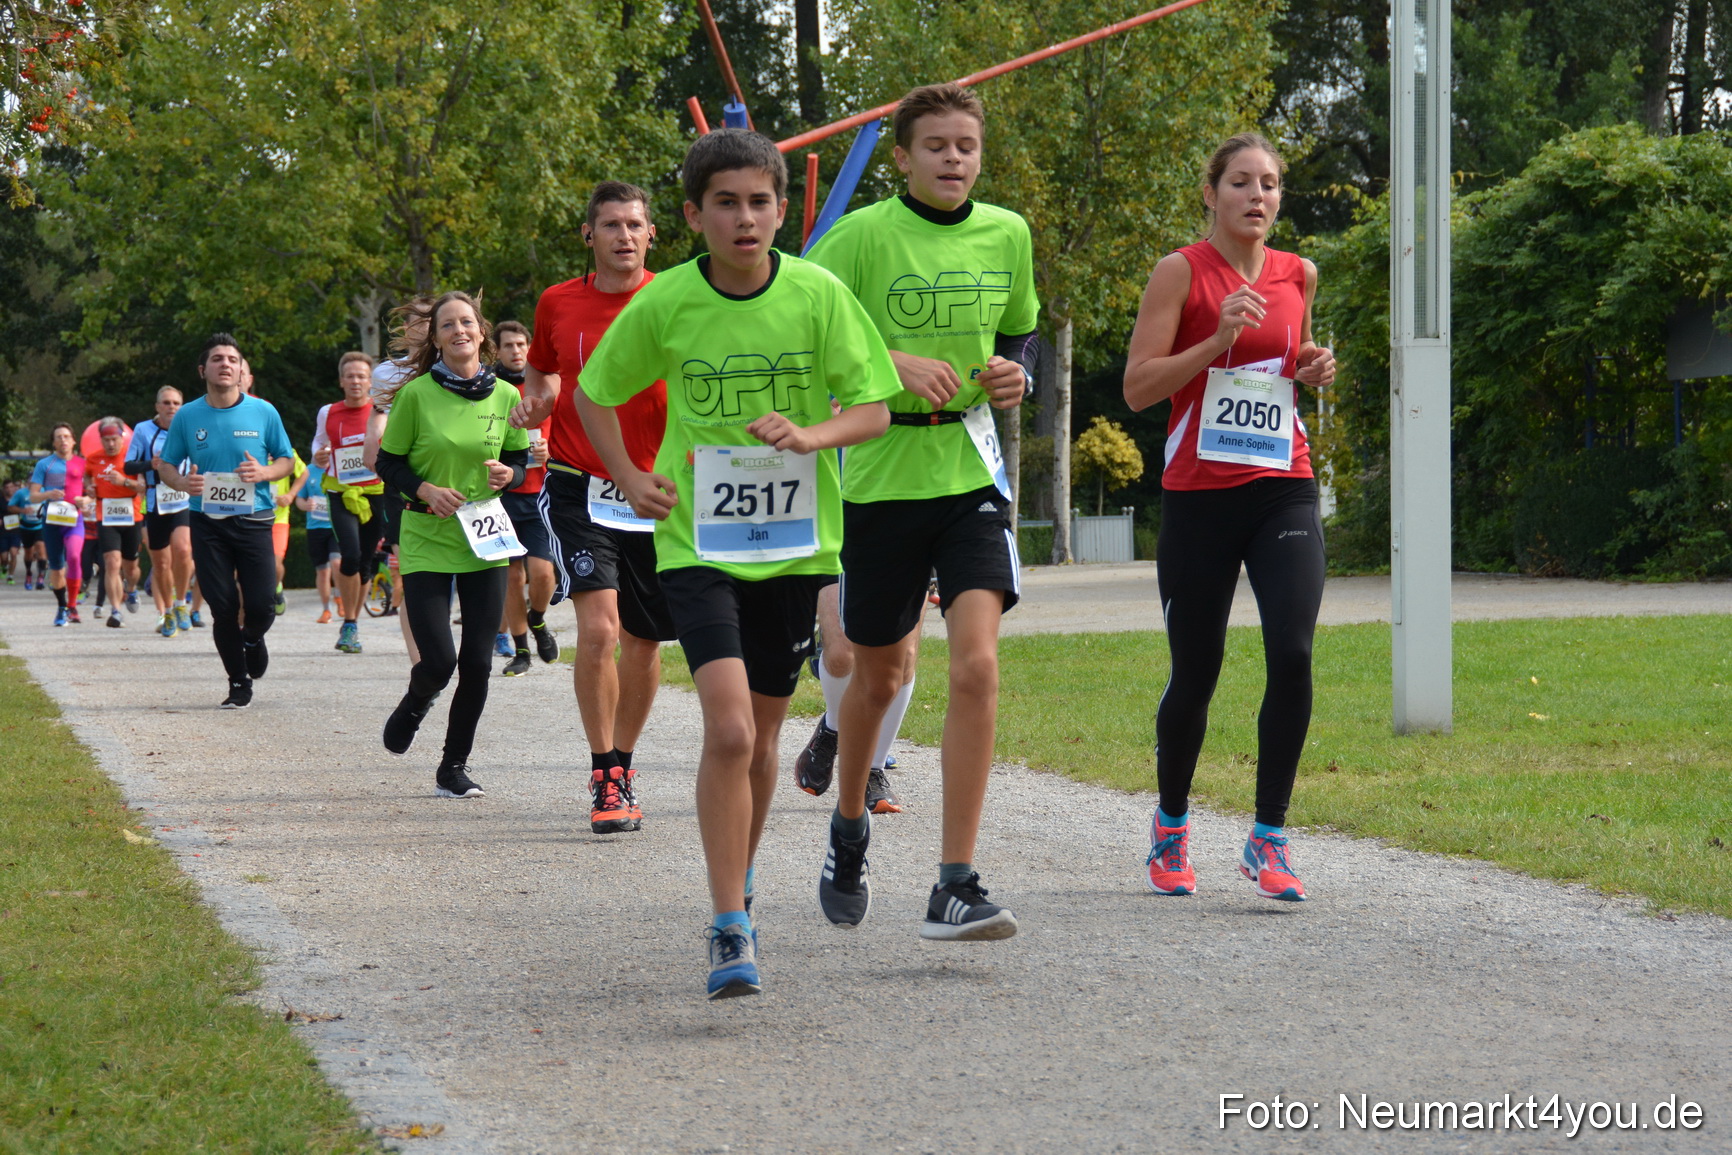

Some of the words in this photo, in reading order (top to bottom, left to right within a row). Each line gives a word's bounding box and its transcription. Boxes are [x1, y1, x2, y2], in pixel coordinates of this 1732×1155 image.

[1243, 379, 1273, 391] BOCK
[1216, 397, 1281, 432] 2050
[1218, 435, 1275, 452] Anne-Sophie
[342, 457, 364, 470] 208
[744, 455, 784, 467] BOCK
[210, 486, 246, 502] 2642
[713, 480, 800, 517] 2517
[612, 508, 639, 519] Thoma
[747, 529, 769, 542] Jan
